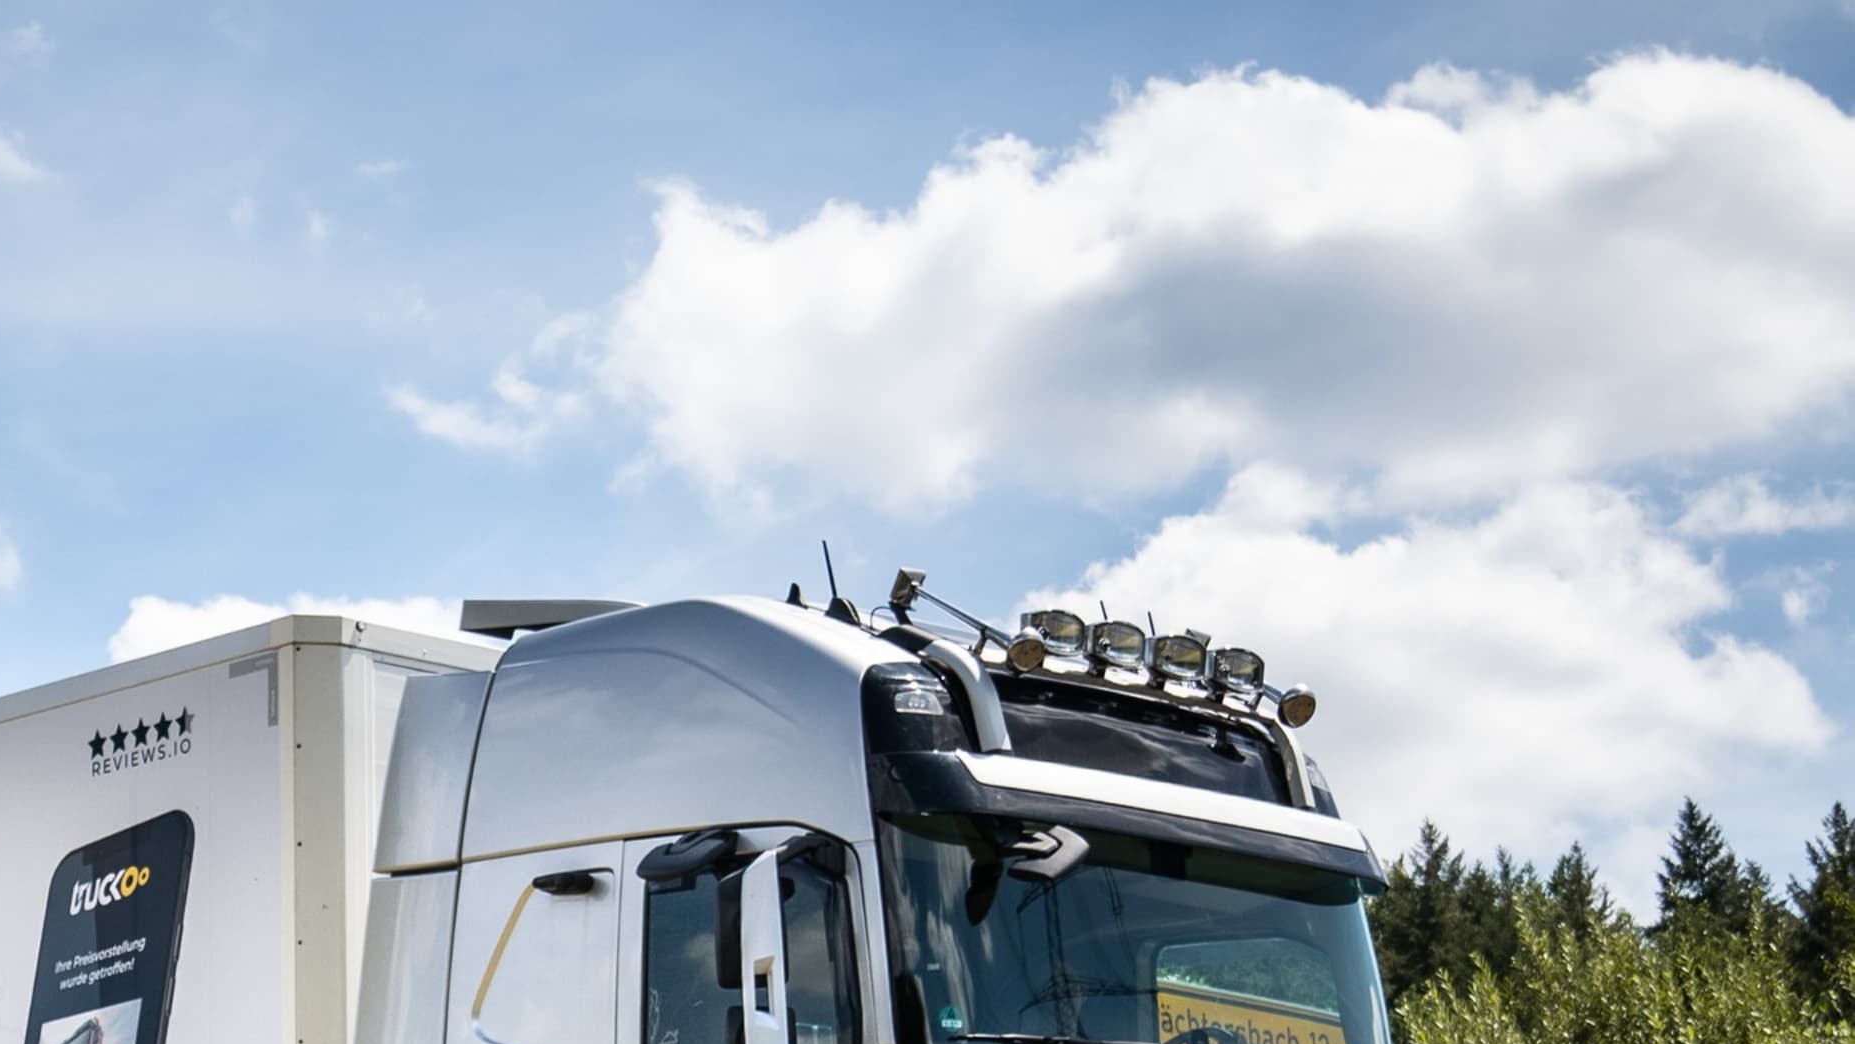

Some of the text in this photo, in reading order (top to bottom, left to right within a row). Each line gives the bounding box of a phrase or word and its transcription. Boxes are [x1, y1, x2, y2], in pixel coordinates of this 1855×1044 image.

[91, 738, 191, 776] REVIEWS.IO
[54, 936, 146, 974] Ihre Preisvorstellung
[59, 956, 135, 990] wurde getroffen!
